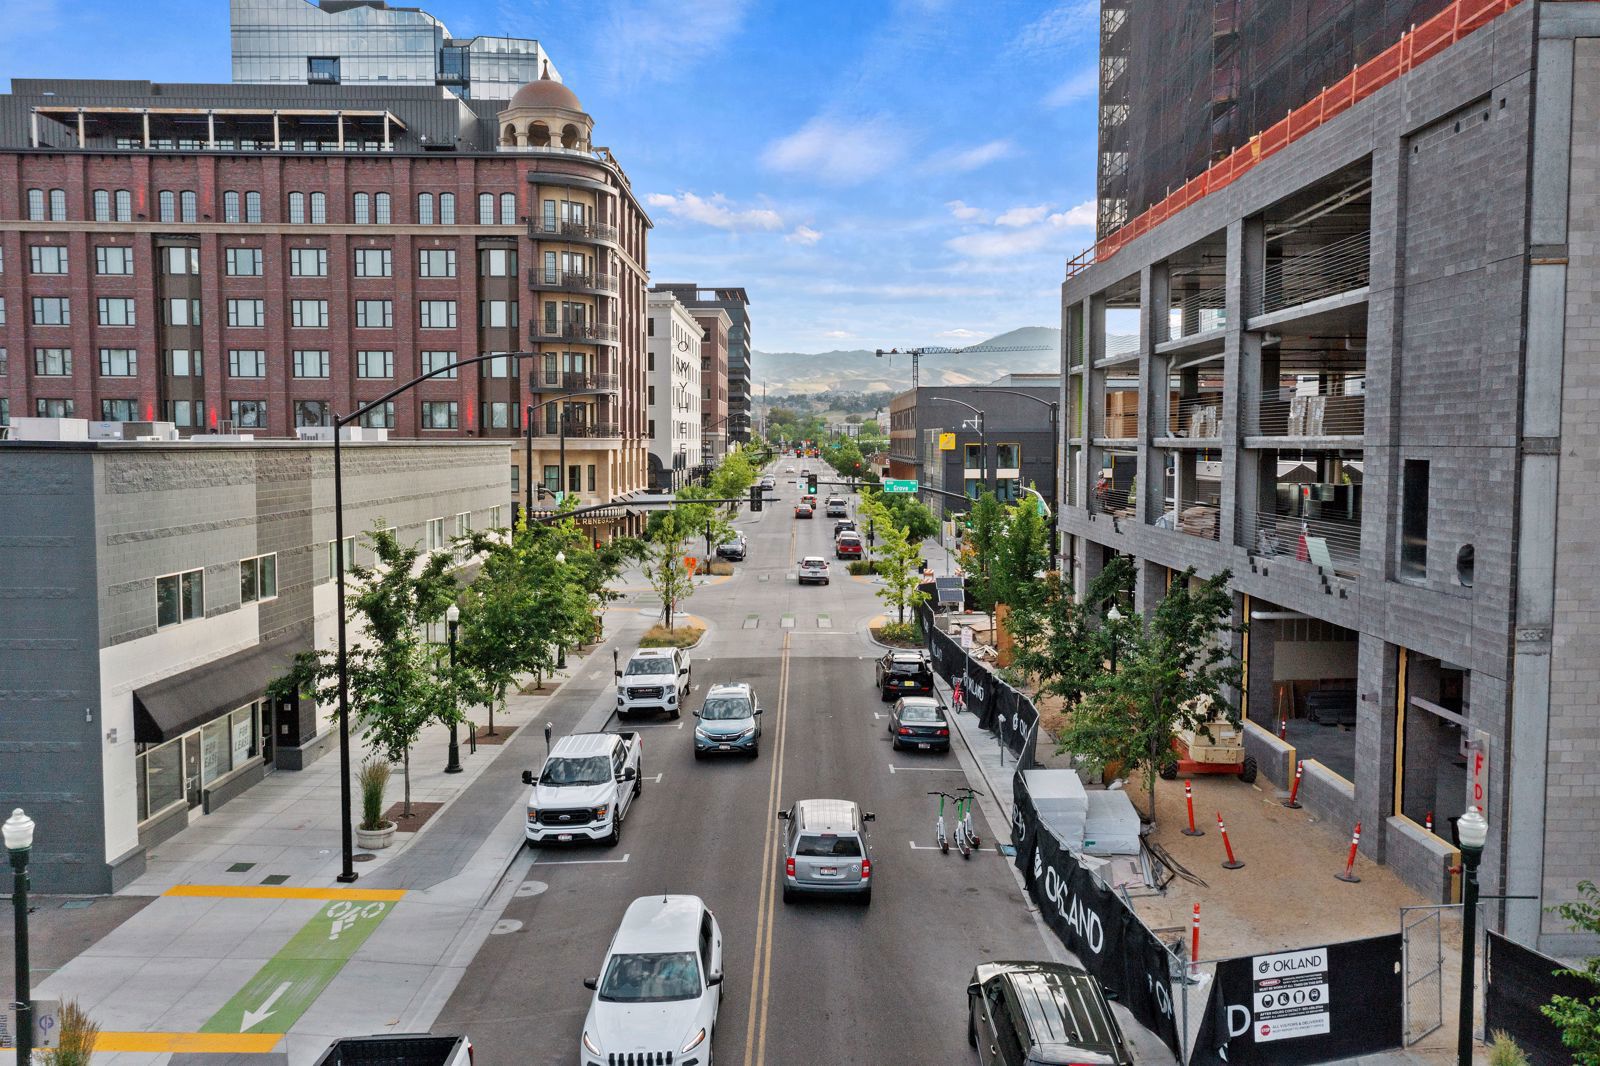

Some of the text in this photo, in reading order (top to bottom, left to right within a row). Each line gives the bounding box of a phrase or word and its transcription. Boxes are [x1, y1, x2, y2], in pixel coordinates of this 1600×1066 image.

[676, 341, 690, 455] OWYHEE
[1045, 866, 1103, 954] OKLAND
[1273, 955, 1322, 972] OKLAND
